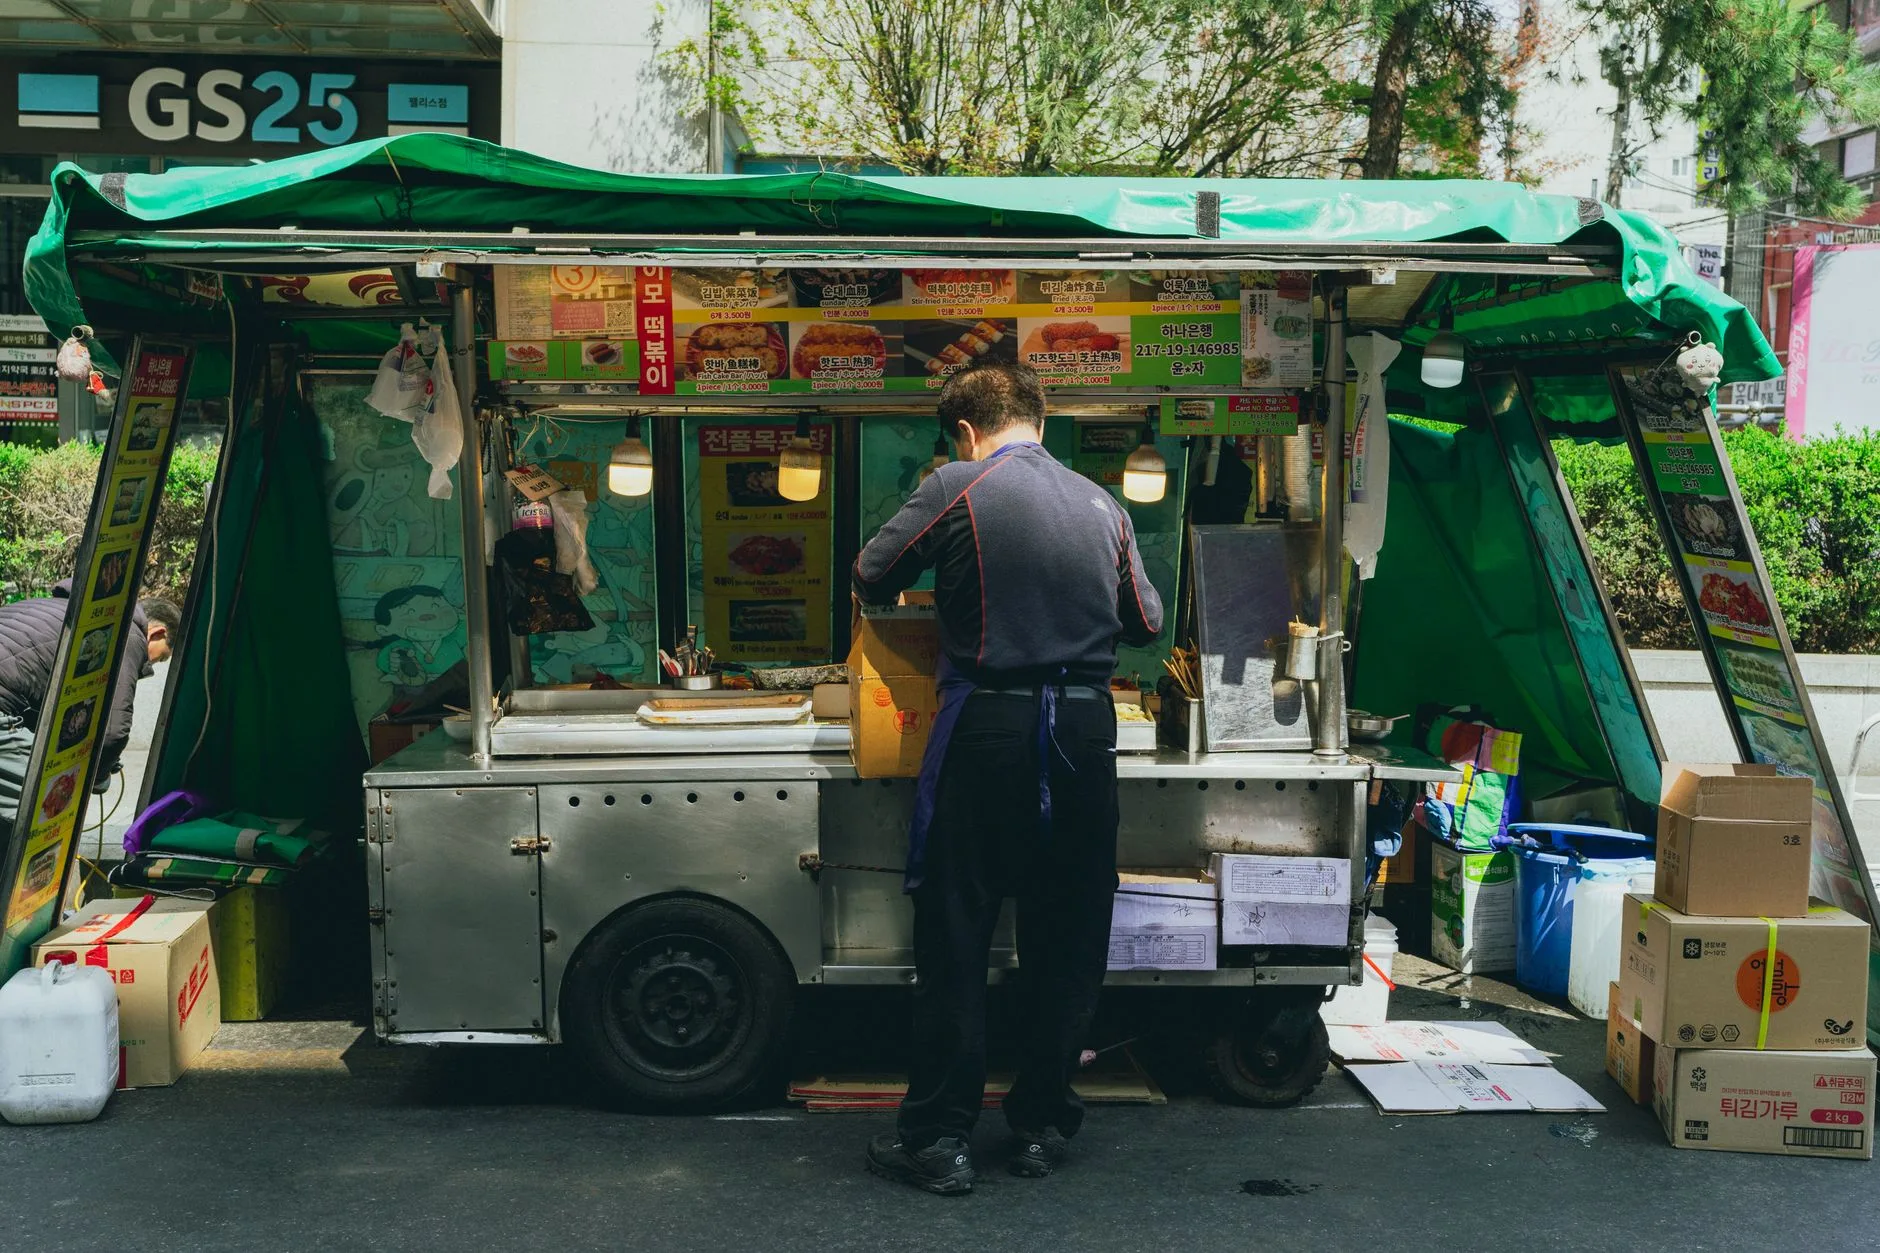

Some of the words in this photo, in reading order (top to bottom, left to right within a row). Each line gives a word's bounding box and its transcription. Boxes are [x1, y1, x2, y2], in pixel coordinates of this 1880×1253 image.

[128, 67, 359, 146] GS25
[823, 285, 844, 298] 순대
[927, 283, 957, 295] 떡볶이
[1041, 281, 1061, 294] 튀김
[1063, 281, 1106, 293] 油炸食品
[1164, 279, 1184, 292] 어묵
[702, 287, 722, 299] 김밥
[702, 301, 728, 309] Gimbap
[1054, 306, 1066, 314] 4개
[1152, 304, 1176, 313] 1piece
[1196, 303, 1221, 311] 1,500원
[724, 311, 752, 319] 3,500원
[823, 310, 841, 318] 1인분
[937, 308, 955, 316] 1인분
[1161, 323, 1213, 338] 하나은행
[645, 315, 668, 387] 떡볶이
[1135, 343, 1239, 357] 217-19-146985
[820, 357, 850, 368] 핫도그
[852, 356, 874, 368] 热狗
[1029, 352, 1077, 364] 치즈핫도그
[1079, 352, 1121, 364] 芝士热狗
[704, 359, 724, 370] 핫바
[1032, 366, 1053, 374] heese
[1065, 366, 1078, 375] dog
[825, 370, 838, 379] dog
[1040, 376, 1064, 385] 1piece
[1083, 376, 1110, 384] 3,000원
[697, 383, 721, 392] 1piece
[741, 383, 769, 391] 3,000원
[812, 382, 837, 390] 1piece
[856, 381, 883, 389] 3,000원
[1782, 834, 1801, 847] 3호
[1690, 1081, 1708, 1093] 백설
[1828, 1076, 1863, 1089] 취급주의
[1719, 1097, 1799, 1121] 튀김가루
